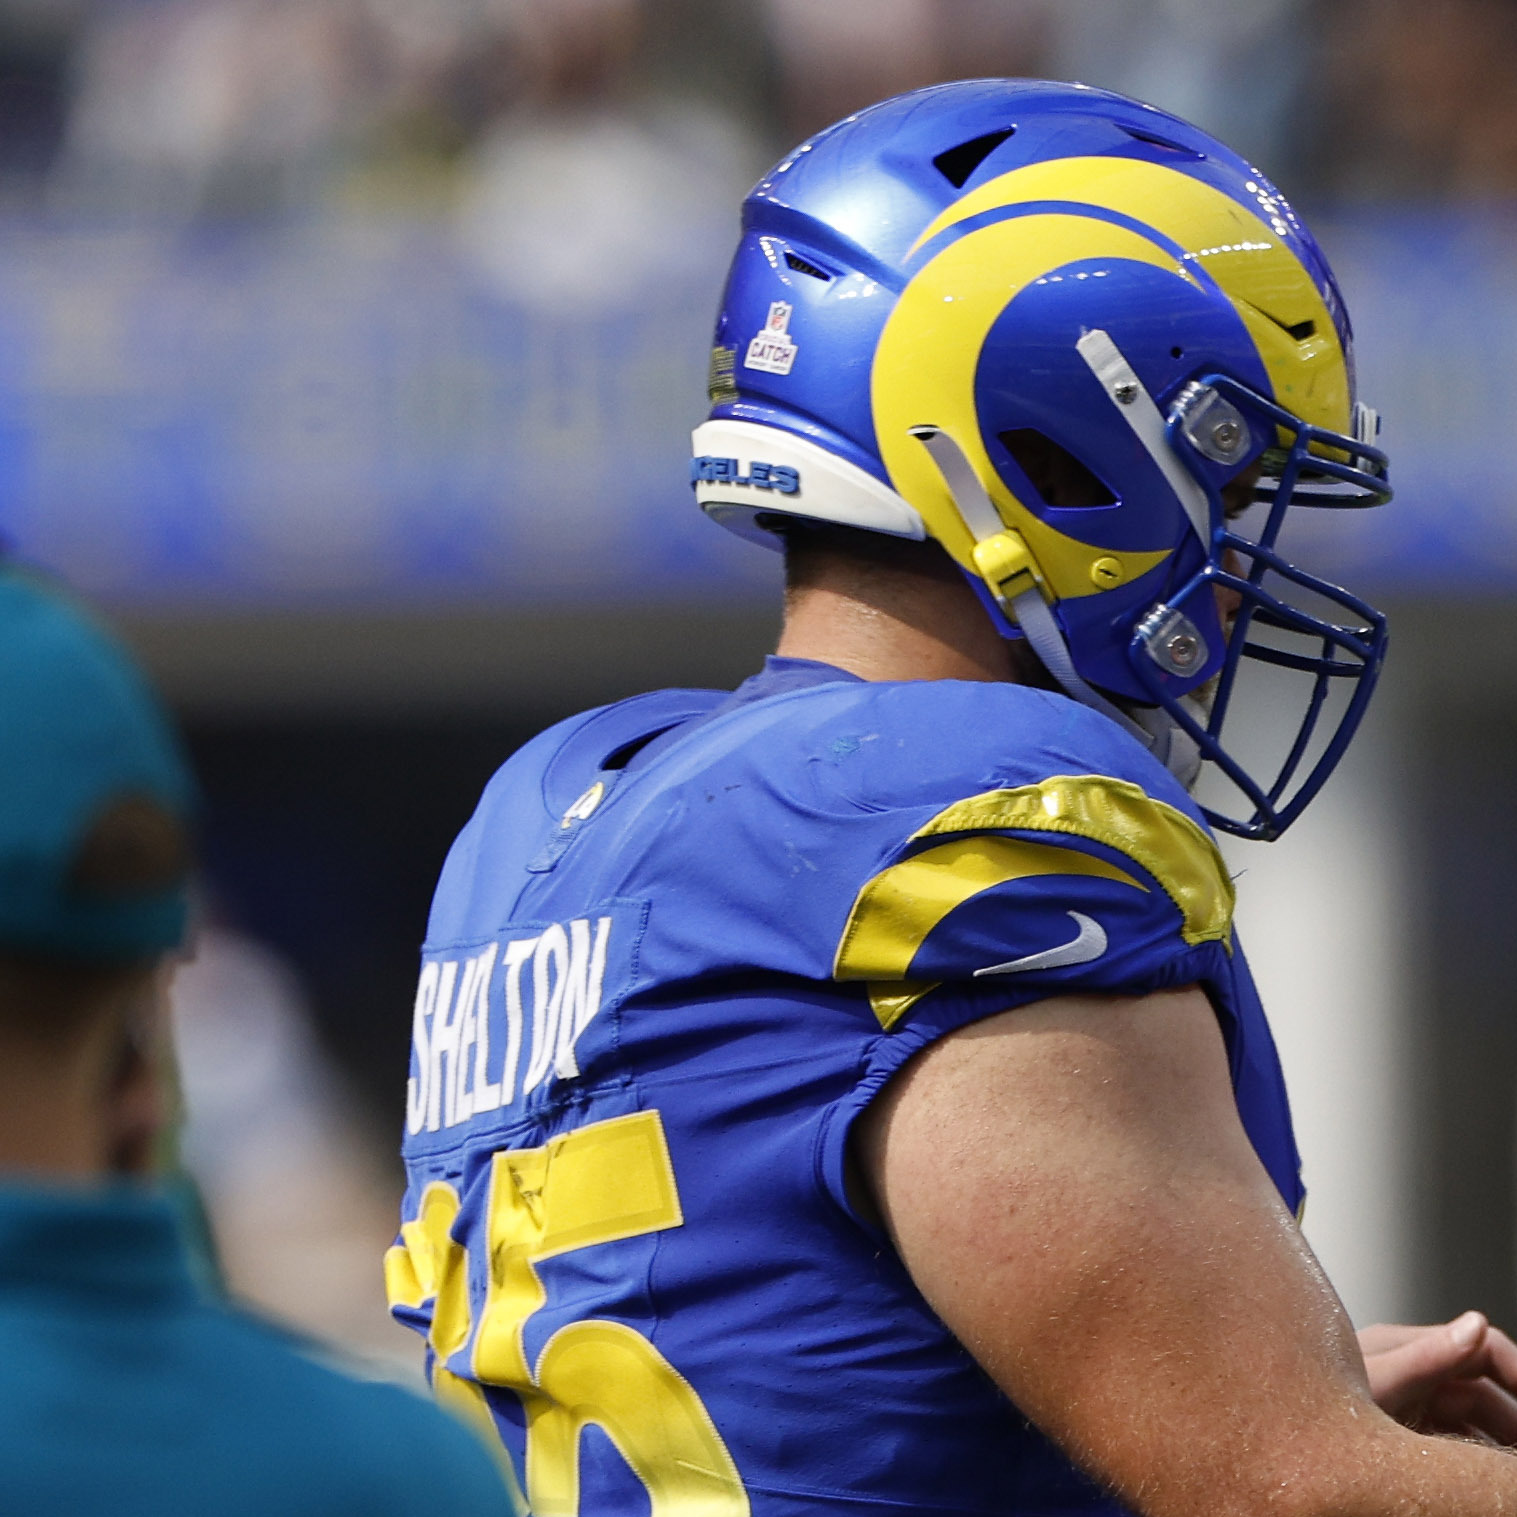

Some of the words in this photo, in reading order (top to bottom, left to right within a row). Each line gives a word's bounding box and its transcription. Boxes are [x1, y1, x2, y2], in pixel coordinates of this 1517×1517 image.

[750, 341, 793, 364] CATCH
[689, 455, 800, 494] GELES
[406, 916, 612, 1136] SHELTON
